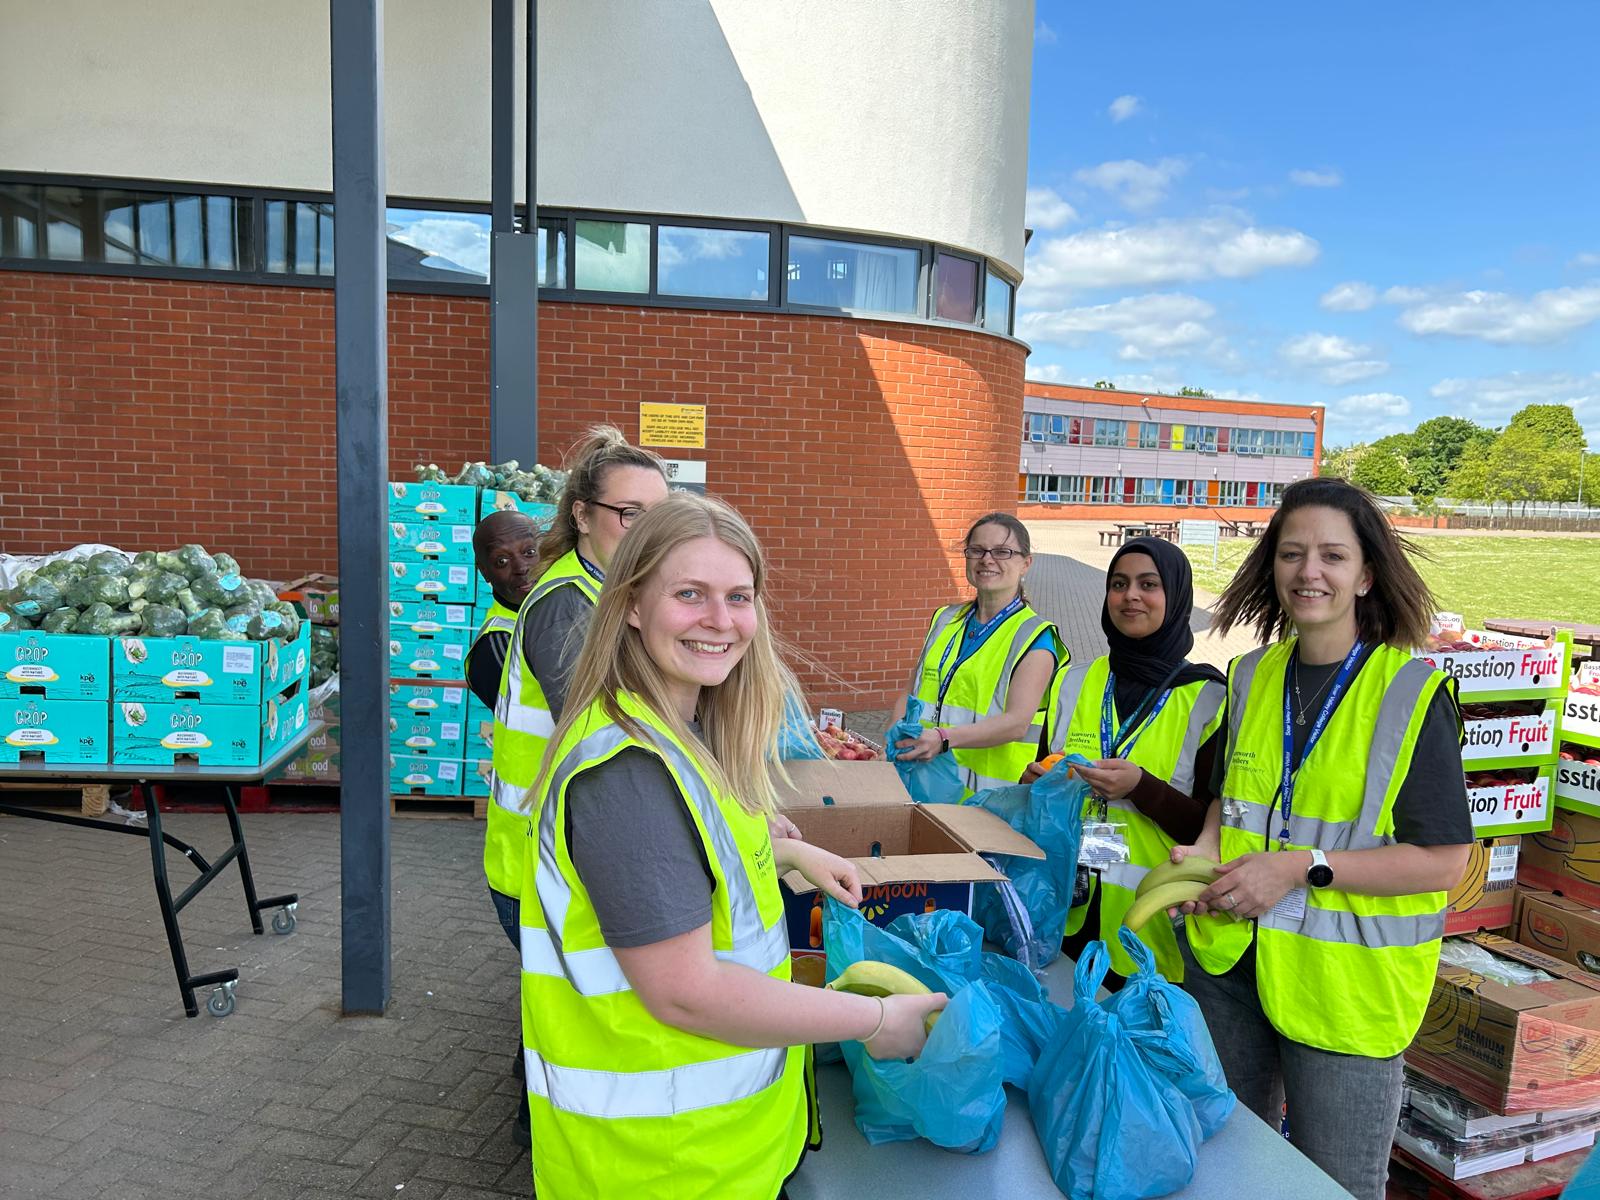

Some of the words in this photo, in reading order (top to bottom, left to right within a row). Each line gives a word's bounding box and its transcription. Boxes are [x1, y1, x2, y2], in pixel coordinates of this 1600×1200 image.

[172, 651, 202, 666] CROP
[1520, 653, 1557, 676] Fruit
[1463, 724, 1503, 748] stion
[1509, 721, 1548, 744] Fruit
[1504, 786, 1542, 810] Fruit
[1482, 880, 1513, 892] BANANAS
[1457, 1024, 1504, 1055] PREMIUM
[1456, 1036, 1504, 1069] BANANAS
